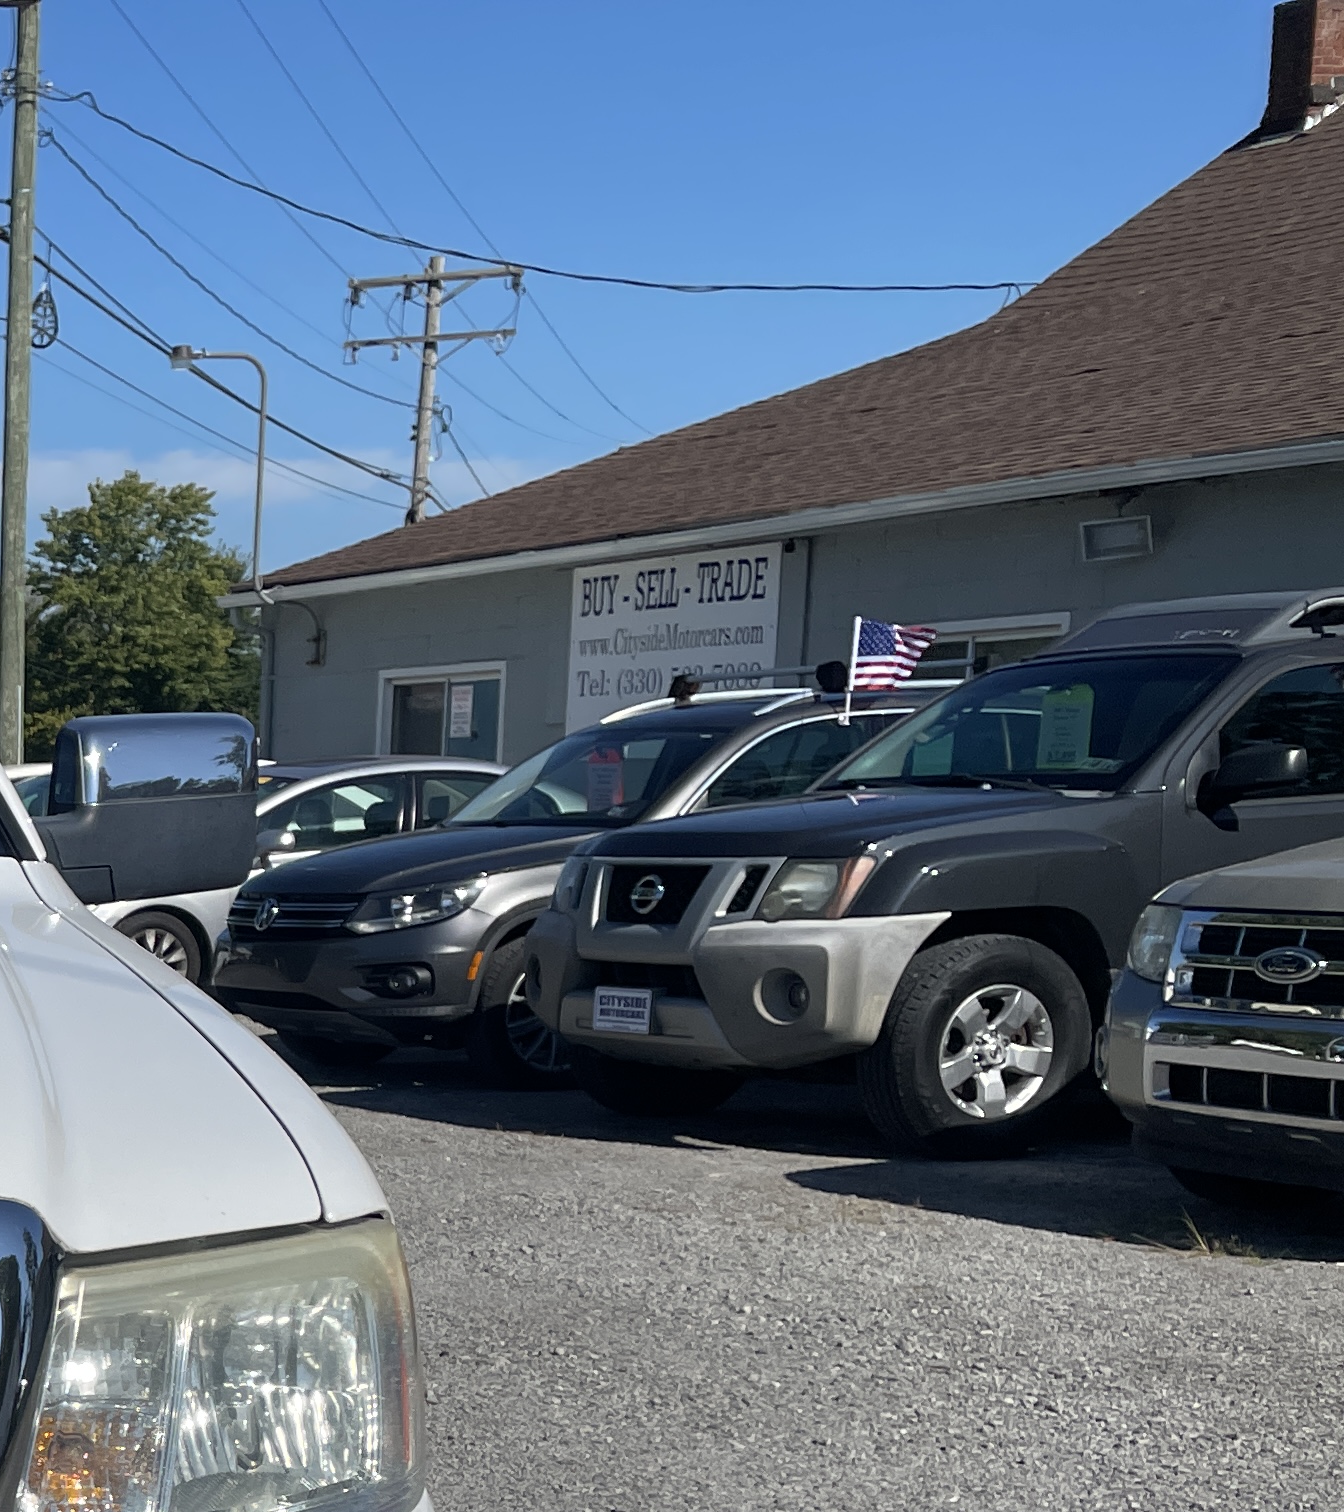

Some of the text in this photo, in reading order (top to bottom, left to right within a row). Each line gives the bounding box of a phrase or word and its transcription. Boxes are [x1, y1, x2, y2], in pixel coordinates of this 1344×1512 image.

[581, 575, 620, 617] BUY
[634, 567, 679, 611] SELL
[698, 557, 769, 604] TRADE
[577, 669, 611, 698] Tel:
[616, 667, 663, 700] (330)
